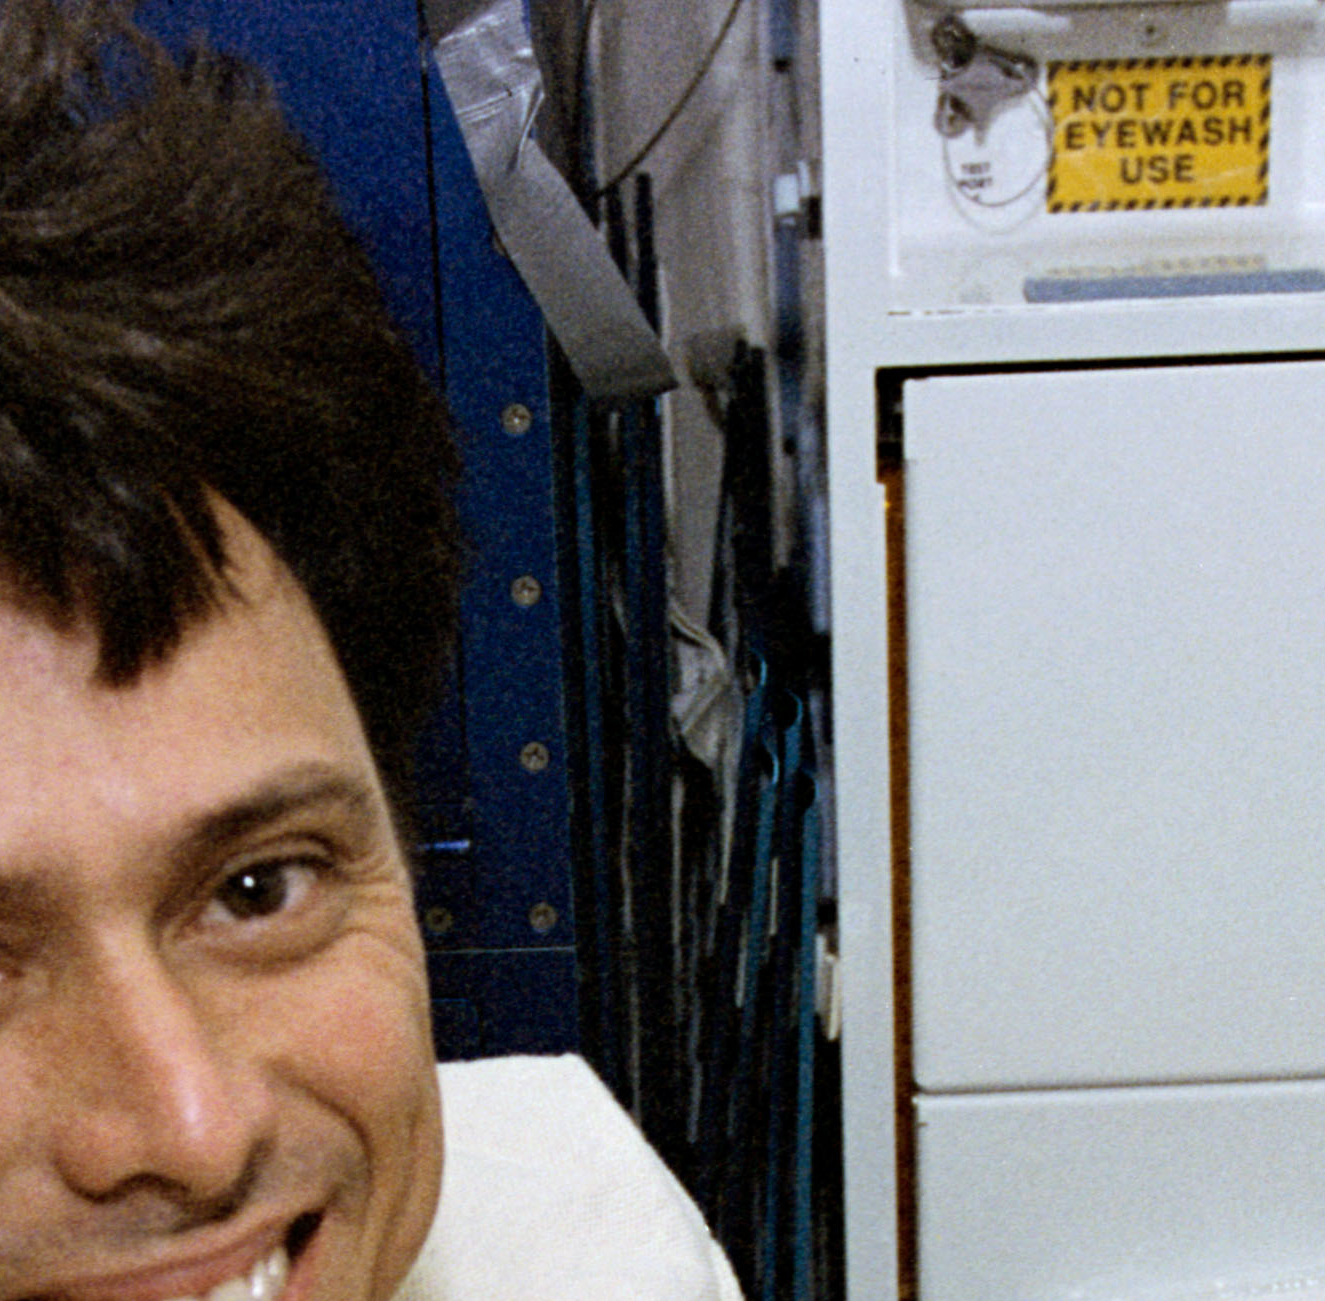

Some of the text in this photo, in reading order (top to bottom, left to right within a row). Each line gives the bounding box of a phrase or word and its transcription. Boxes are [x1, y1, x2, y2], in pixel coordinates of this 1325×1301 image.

[1073, 78, 1246, 113] NOT FOR
[1065, 115, 1252, 150] EYEWASH
[1122, 152, 1195, 185] USE
